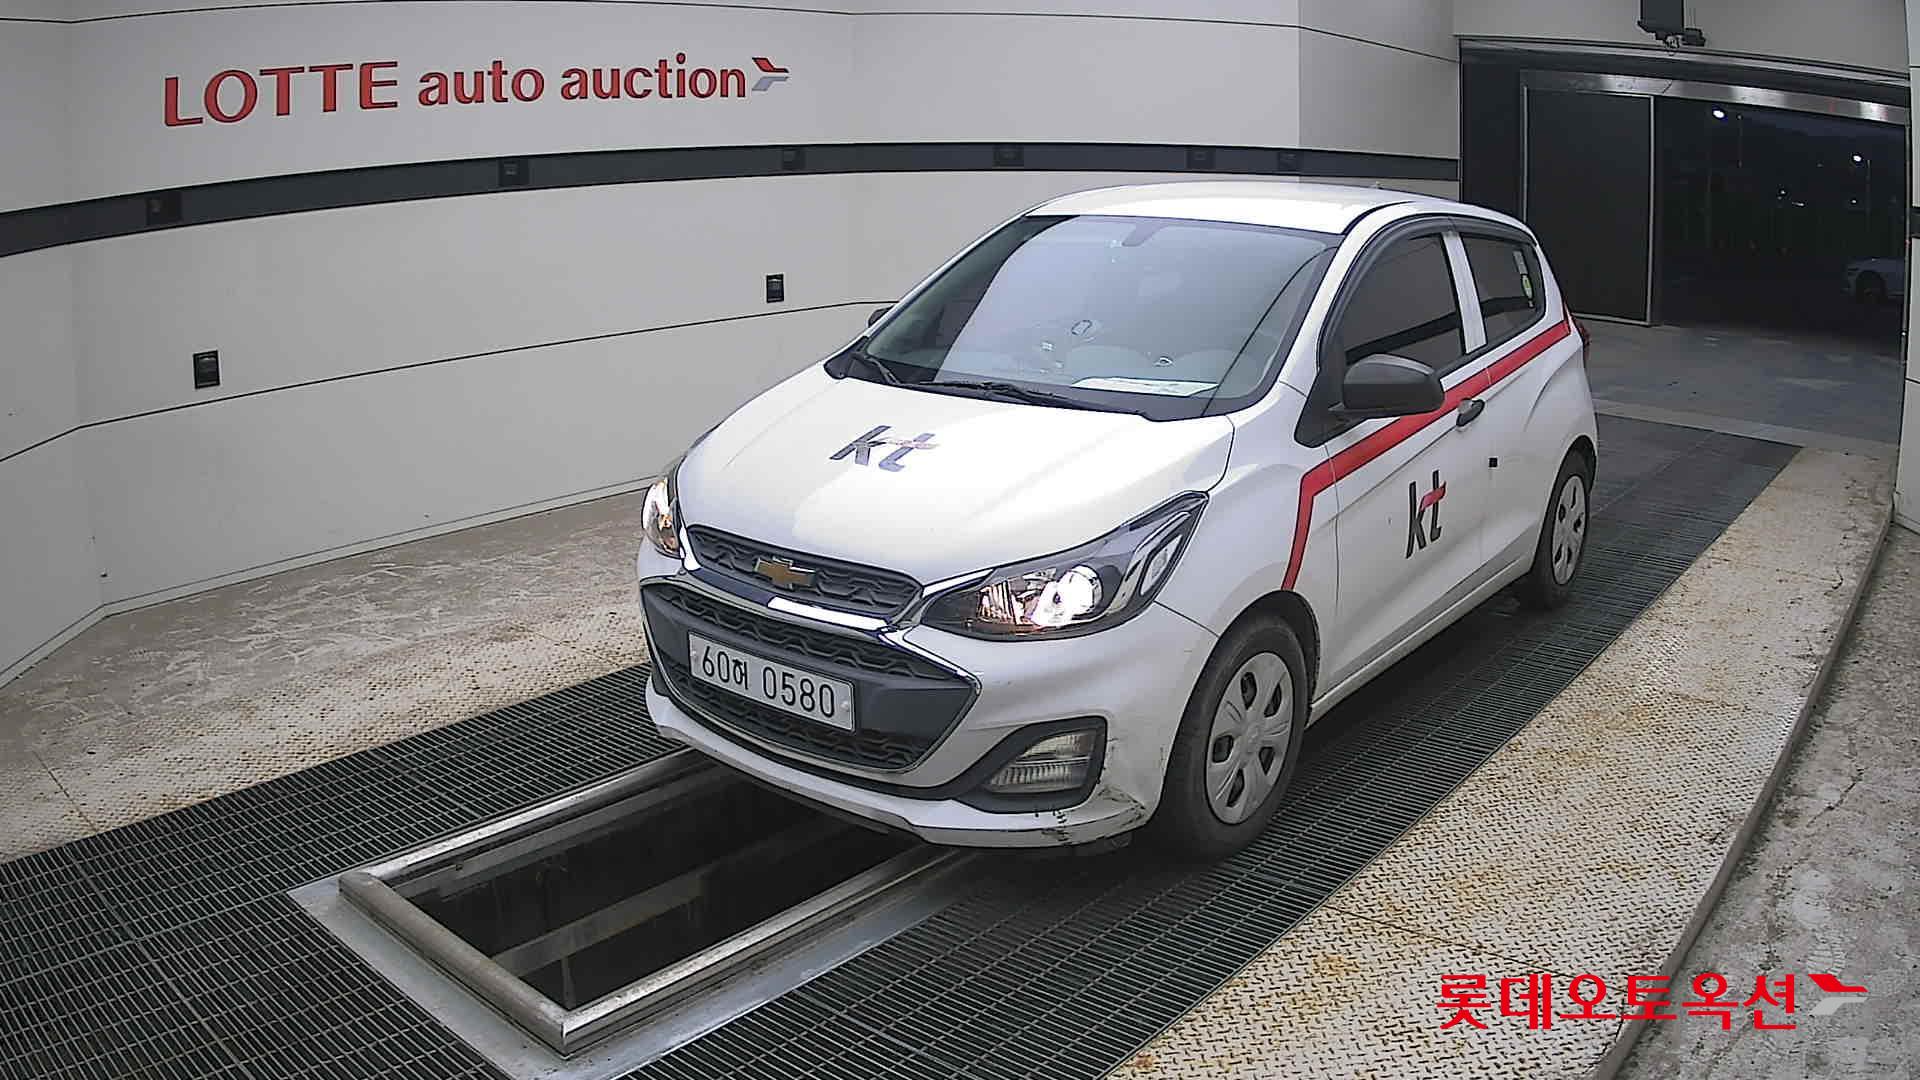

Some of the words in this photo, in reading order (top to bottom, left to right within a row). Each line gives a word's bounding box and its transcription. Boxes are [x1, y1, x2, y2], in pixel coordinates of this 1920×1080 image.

[164, 60, 398, 127] LOTTE
[418, 60, 545, 107] auto
[560, 52, 746, 101] auction
[829, 425, 938, 472] kt
[1406, 469, 1446, 559] kt
[762, 666, 836, 718] 0580
